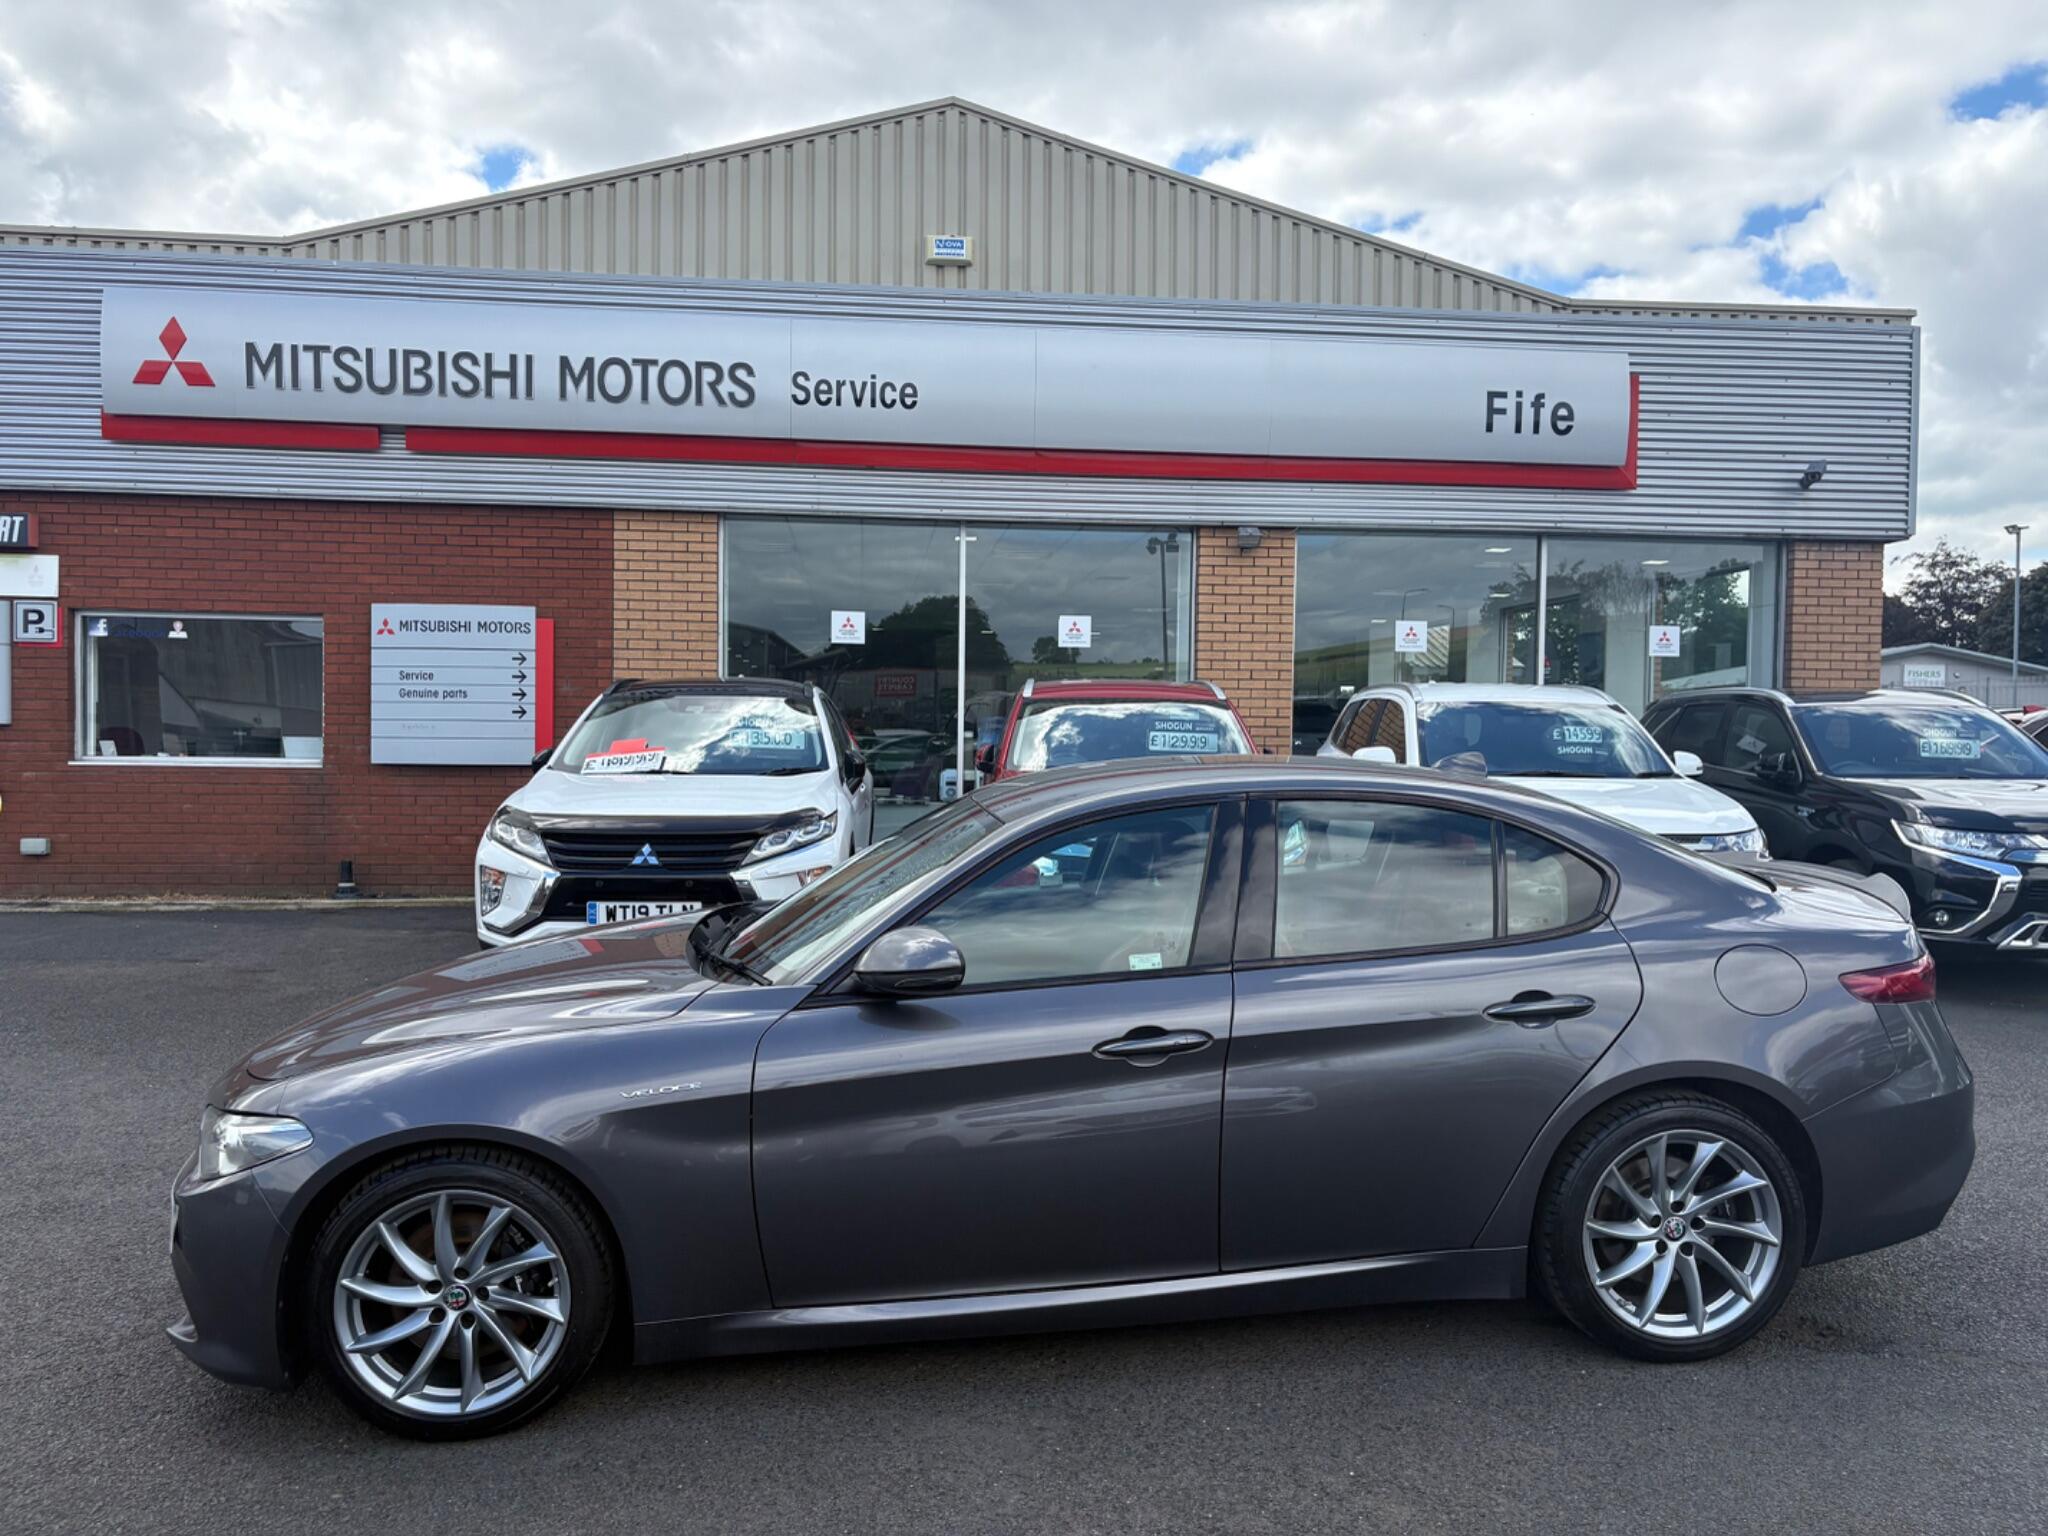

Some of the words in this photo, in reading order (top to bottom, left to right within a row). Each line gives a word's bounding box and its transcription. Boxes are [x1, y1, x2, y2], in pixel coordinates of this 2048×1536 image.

[245, 342, 535, 401] MITSUBISHI
[559, 355, 757, 408] MOTORS
[791, 370, 919, 410] Service
[1485, 390, 1575, 436] Fife
[399, 620, 472, 633] MITSUBISHI
[477, 621, 532, 634] MOTORS
[399, 670, 434, 681] Service
[399, 688, 439, 699] Genuine
[443, 689, 468, 700] parts
[1155, 721, 1193, 731] SHOGUN
[1150, 734, 1208, 748] £12999
[1557, 746, 1593, 754] SHOGUN
[605, 905, 650, 922] WT19
